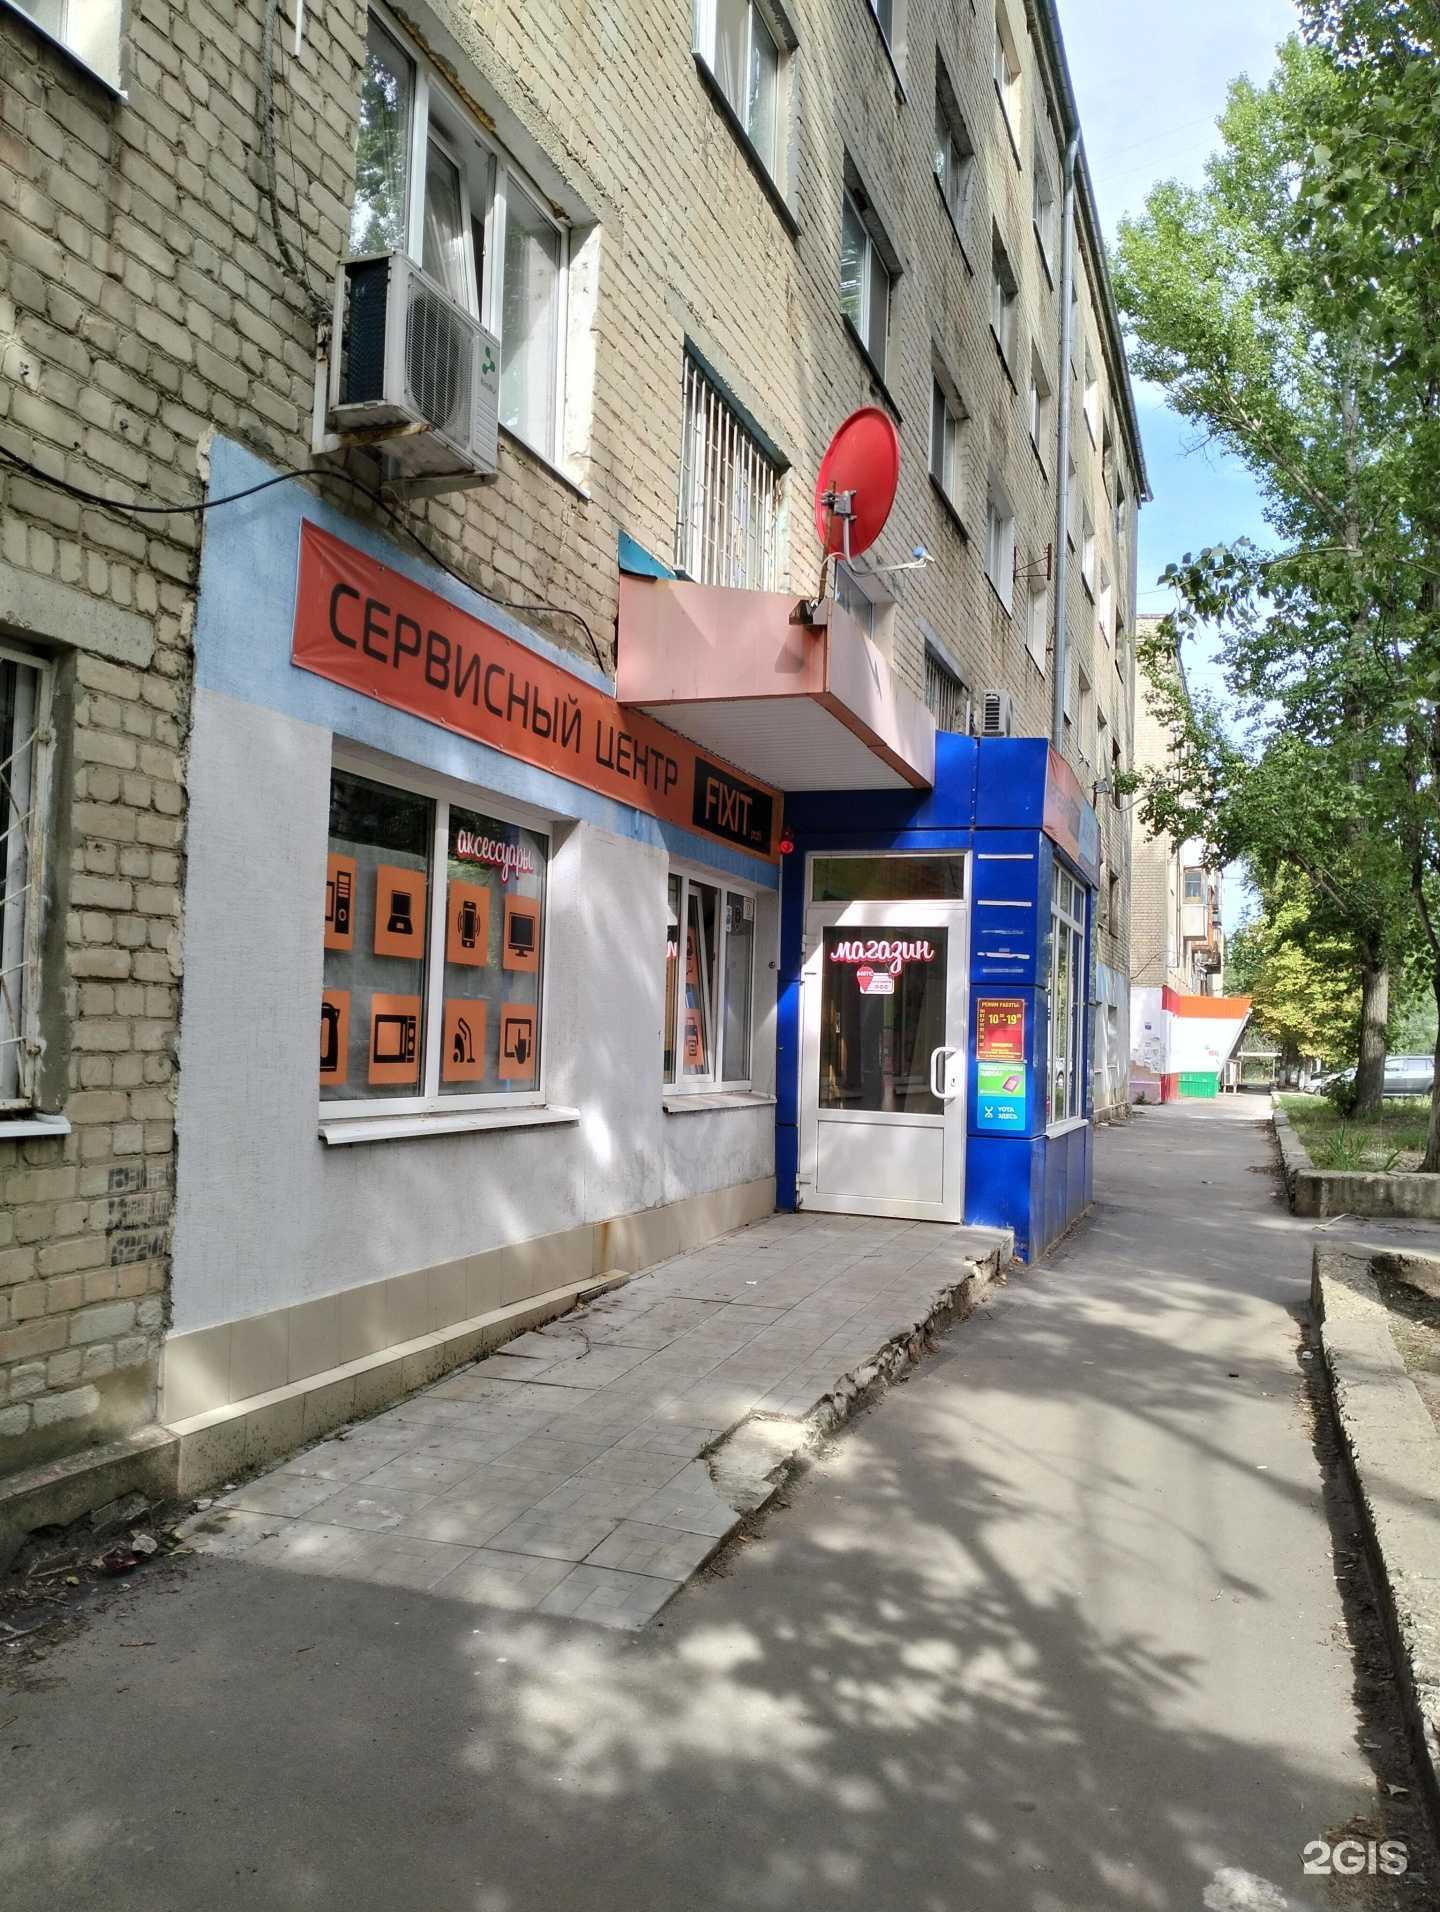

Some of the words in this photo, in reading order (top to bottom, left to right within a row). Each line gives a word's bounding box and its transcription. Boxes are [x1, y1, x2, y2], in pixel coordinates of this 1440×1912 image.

[329, 582, 582, 754] СЕРВИСНЫЙ
[595, 719, 679, 796] ЦЕНТР
[704, 776, 753, 837] FIXIT
[457, 829, 535, 882] аксессуары
[830, 940, 935, 975] магазин
